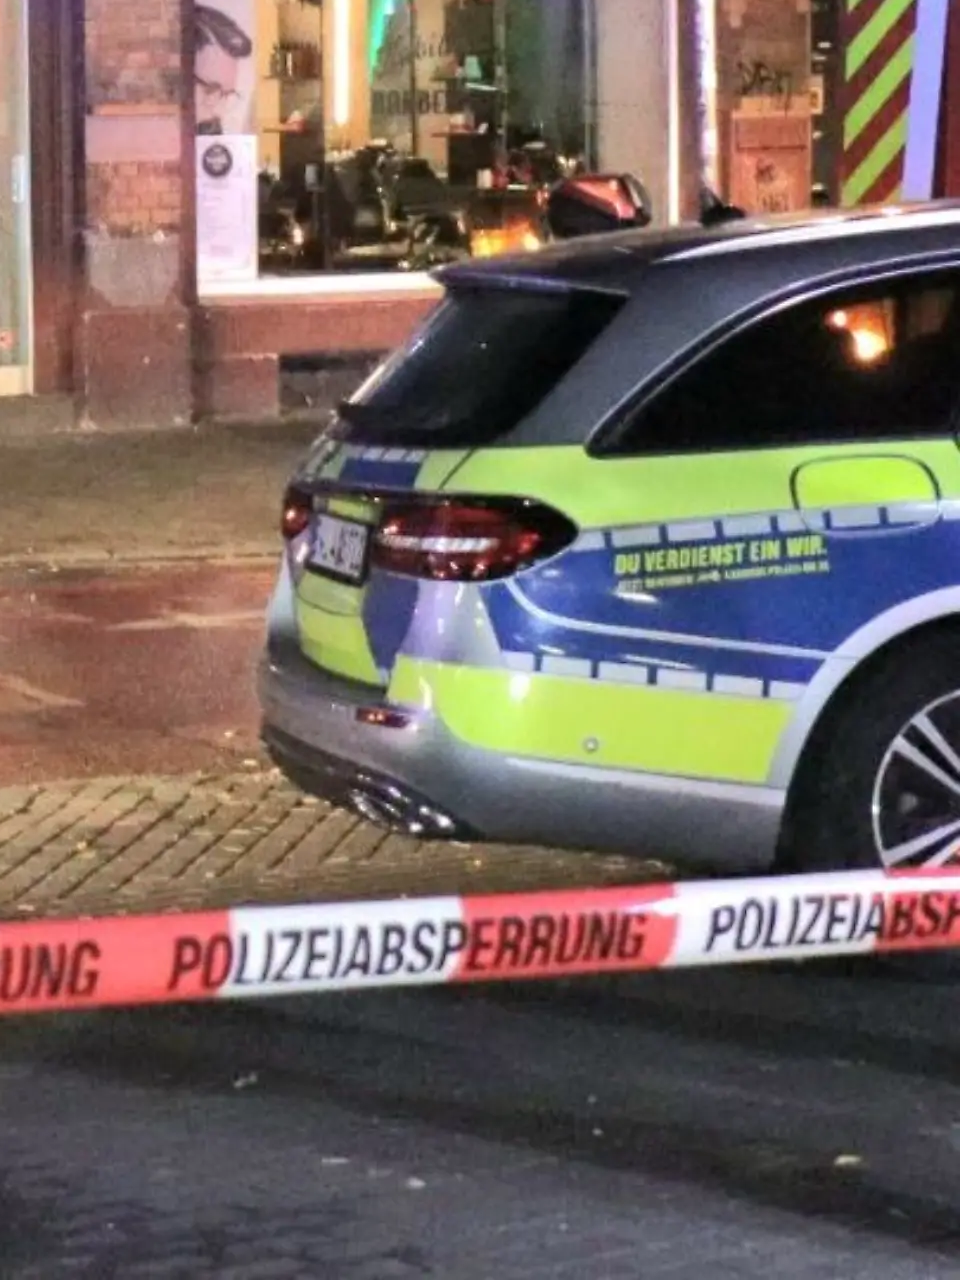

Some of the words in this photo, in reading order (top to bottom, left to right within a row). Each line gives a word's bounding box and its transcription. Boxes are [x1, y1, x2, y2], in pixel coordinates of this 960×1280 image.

[614, 553, 640, 576] DU
[643, 542, 746, 572] VERDIENST
[749, 540, 781, 562] EIN
[169, 910, 648, 989] POLIZEIABSPERRUNG
